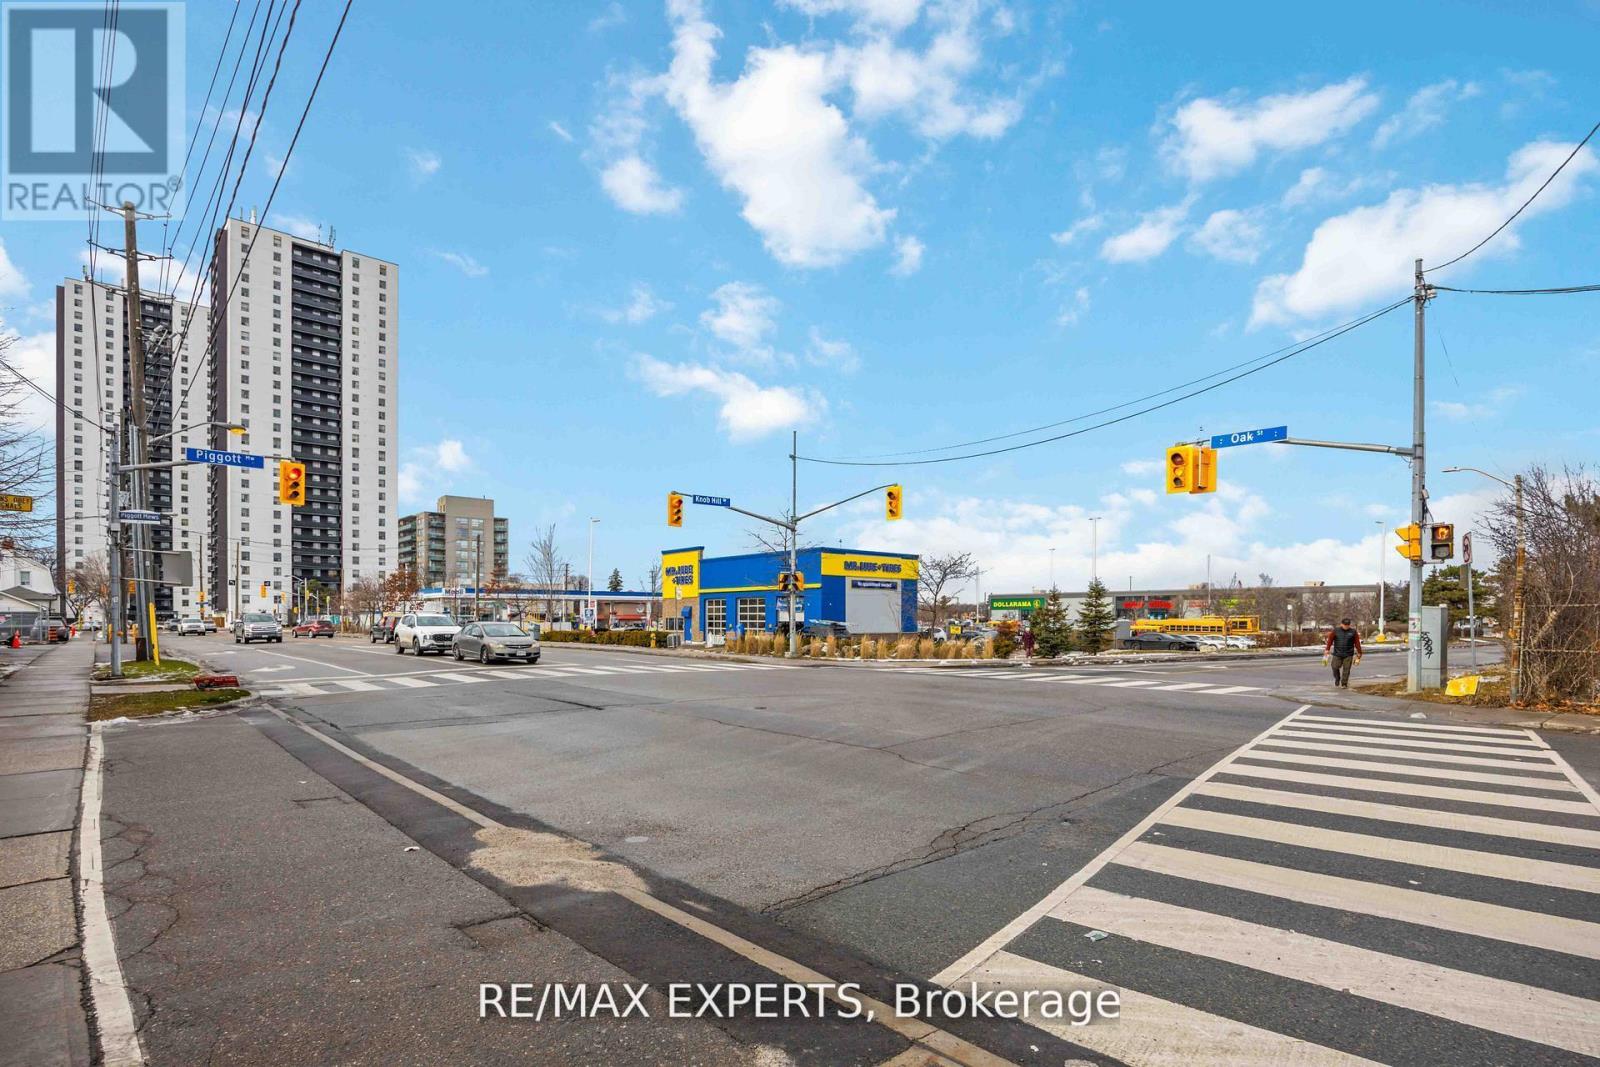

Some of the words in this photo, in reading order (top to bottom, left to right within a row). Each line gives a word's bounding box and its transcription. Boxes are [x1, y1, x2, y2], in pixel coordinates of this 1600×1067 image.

[1231, 431, 1254, 444] Oak
[196, 449, 242, 464] Piggott
[695, 495, 711, 504] Knob
[711, 497, 722, 505] Hill
[120, 512, 142, 520] Piggott
